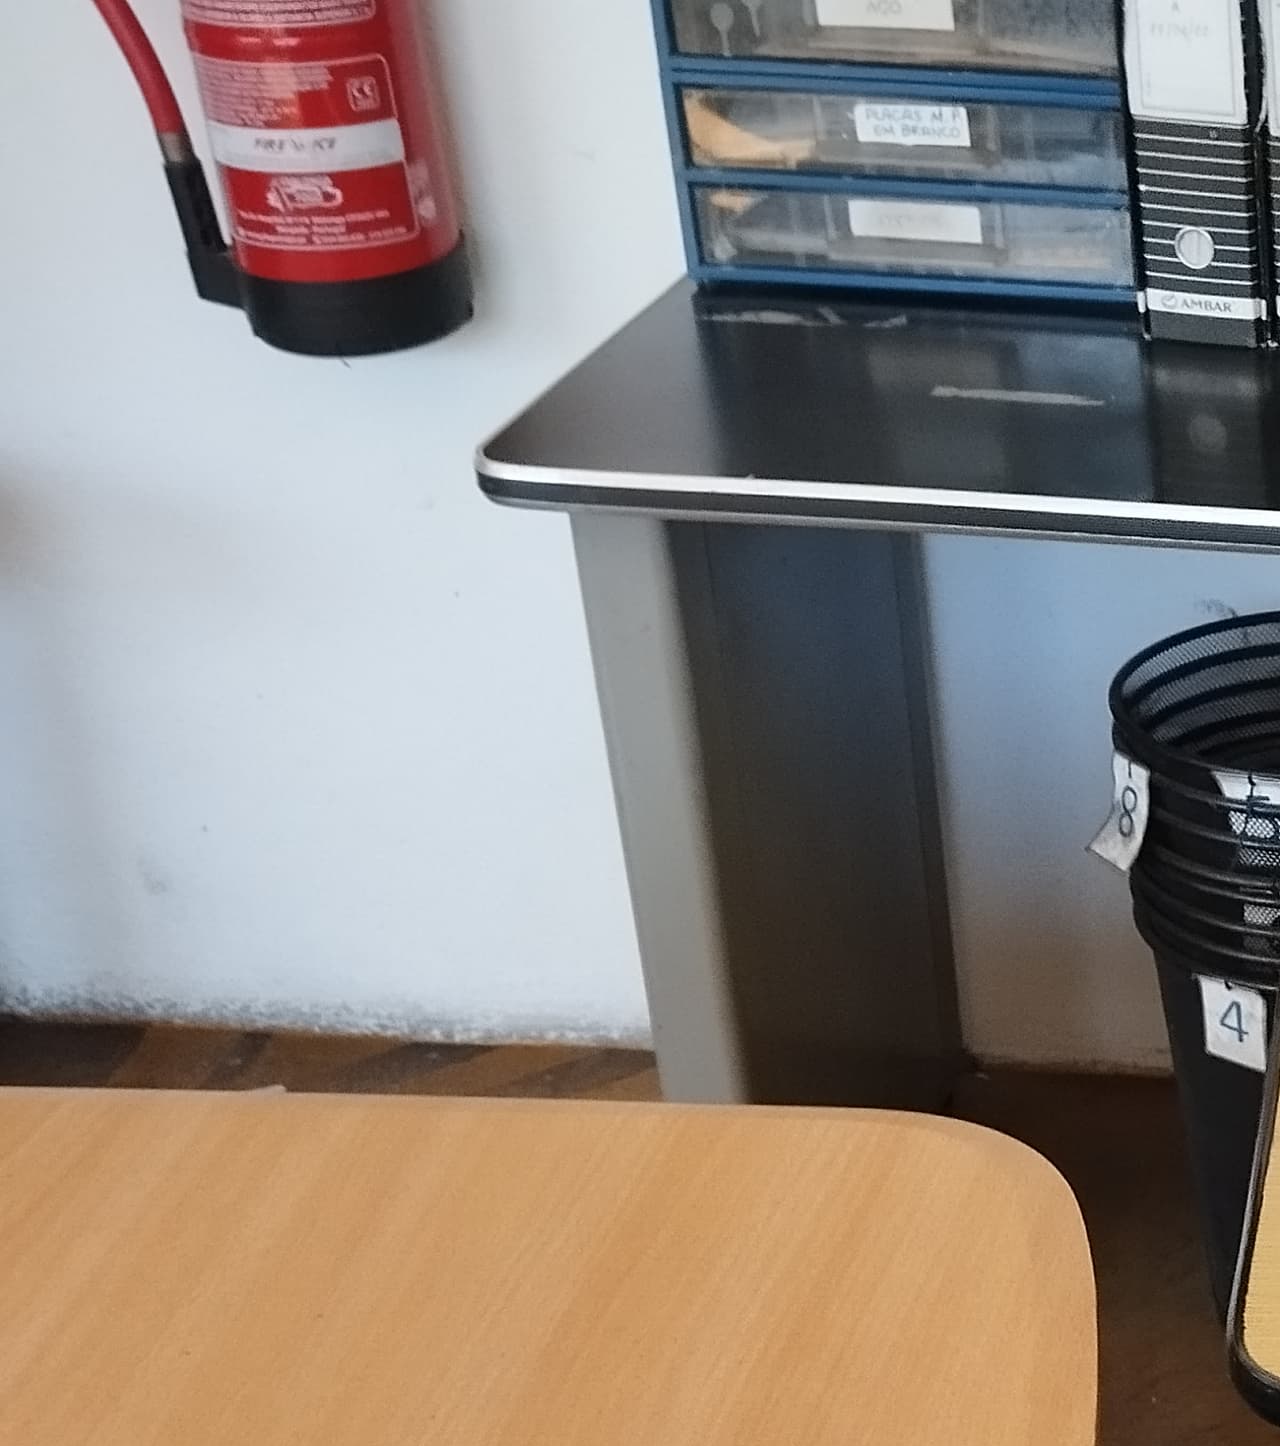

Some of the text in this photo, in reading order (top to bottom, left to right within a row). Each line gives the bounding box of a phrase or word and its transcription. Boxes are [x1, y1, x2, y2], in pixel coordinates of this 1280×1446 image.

[1180, 298, 1232, 313] AMBAR
[1118, 785, 1138, 838] 8
[1219, 1000, 1249, 1043] 4
